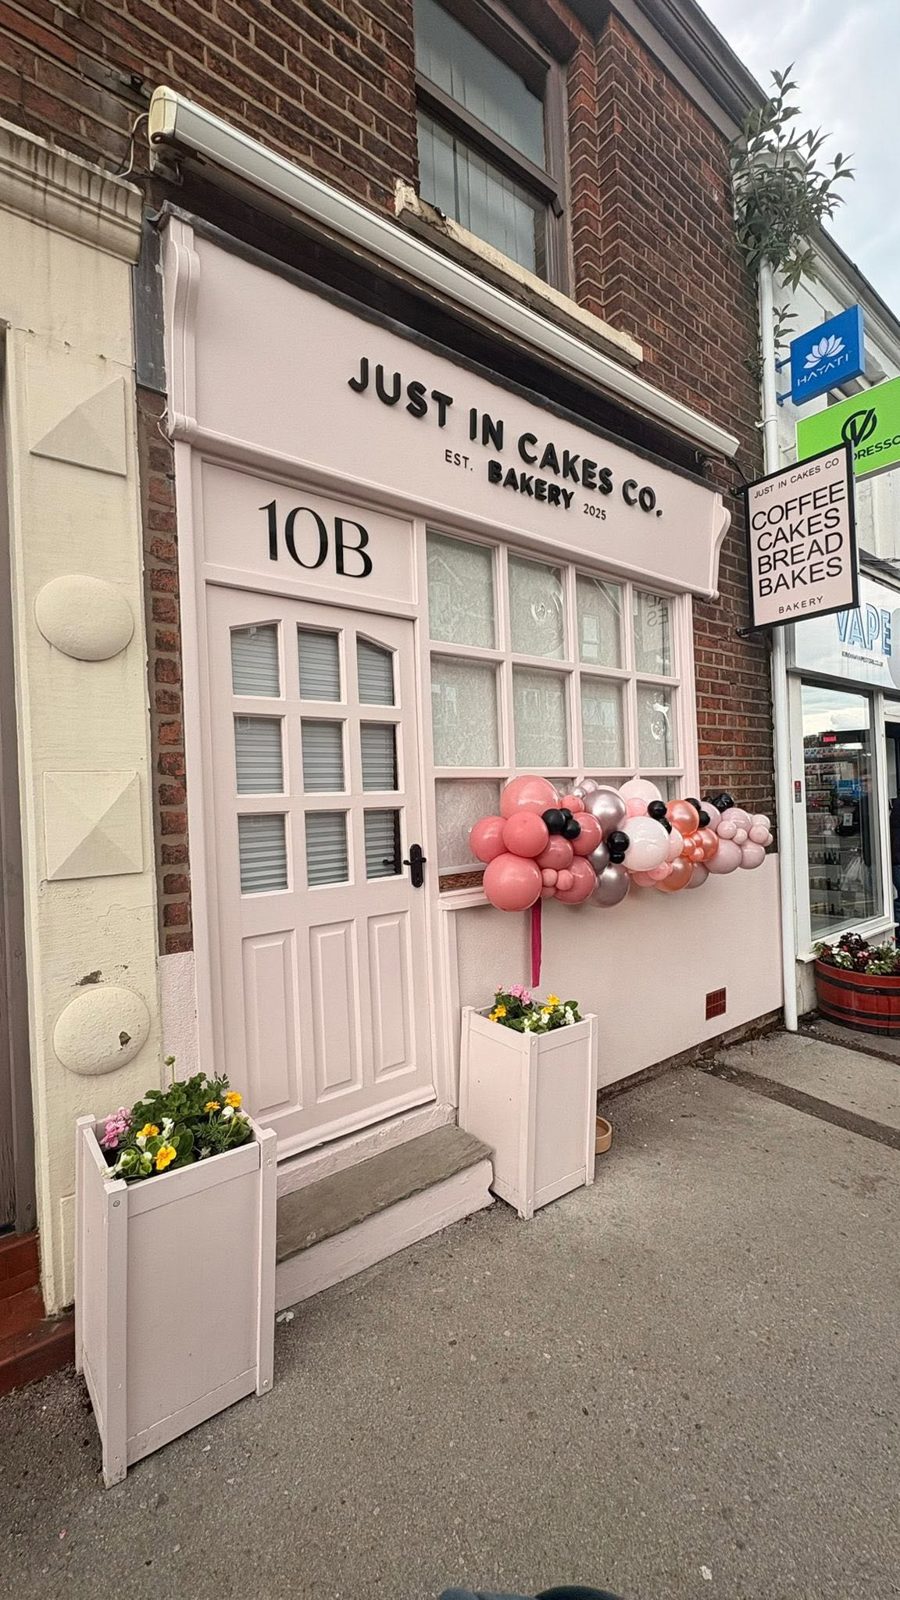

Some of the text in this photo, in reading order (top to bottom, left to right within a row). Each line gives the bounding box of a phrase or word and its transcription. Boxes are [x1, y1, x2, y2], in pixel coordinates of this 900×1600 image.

[797, 353, 849, 387] HAYATI
[348, 357, 663, 518] JUST IN CAKES CO.
[444, 448, 607, 521] EST. BAKERY 2025
[754, 457, 840, 499] JUST IN CAKES CO
[751, 480, 845, 531] COFFEE
[258, 499, 373, 579] 10B
[757, 507, 841, 552] CAKES
[758, 531, 843, 576] BREAD
[759, 556, 843, 598] BAKES
[778, 595, 824, 614] BAKERY
[836, 602, 892, 656] VAPE
